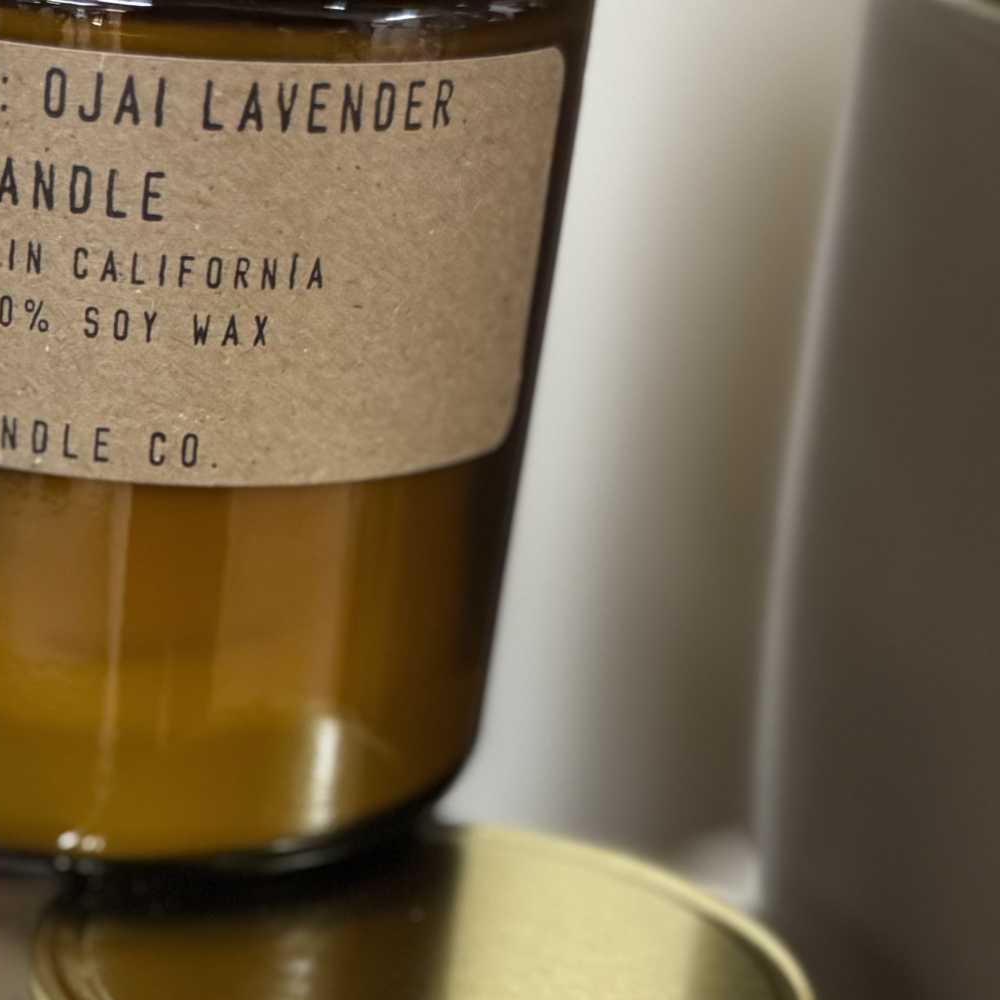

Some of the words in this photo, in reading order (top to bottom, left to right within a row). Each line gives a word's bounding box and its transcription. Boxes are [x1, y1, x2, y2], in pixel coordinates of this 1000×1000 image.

[44, 67, 166, 128] OJAI
[201, 78, 456, 133] LAVENDER
[8, 237, 43, 275] IN
[83, 308, 158, 345] SOY
[192, 313, 269, 347] WAX
[149, 433, 218, 469] CO.
